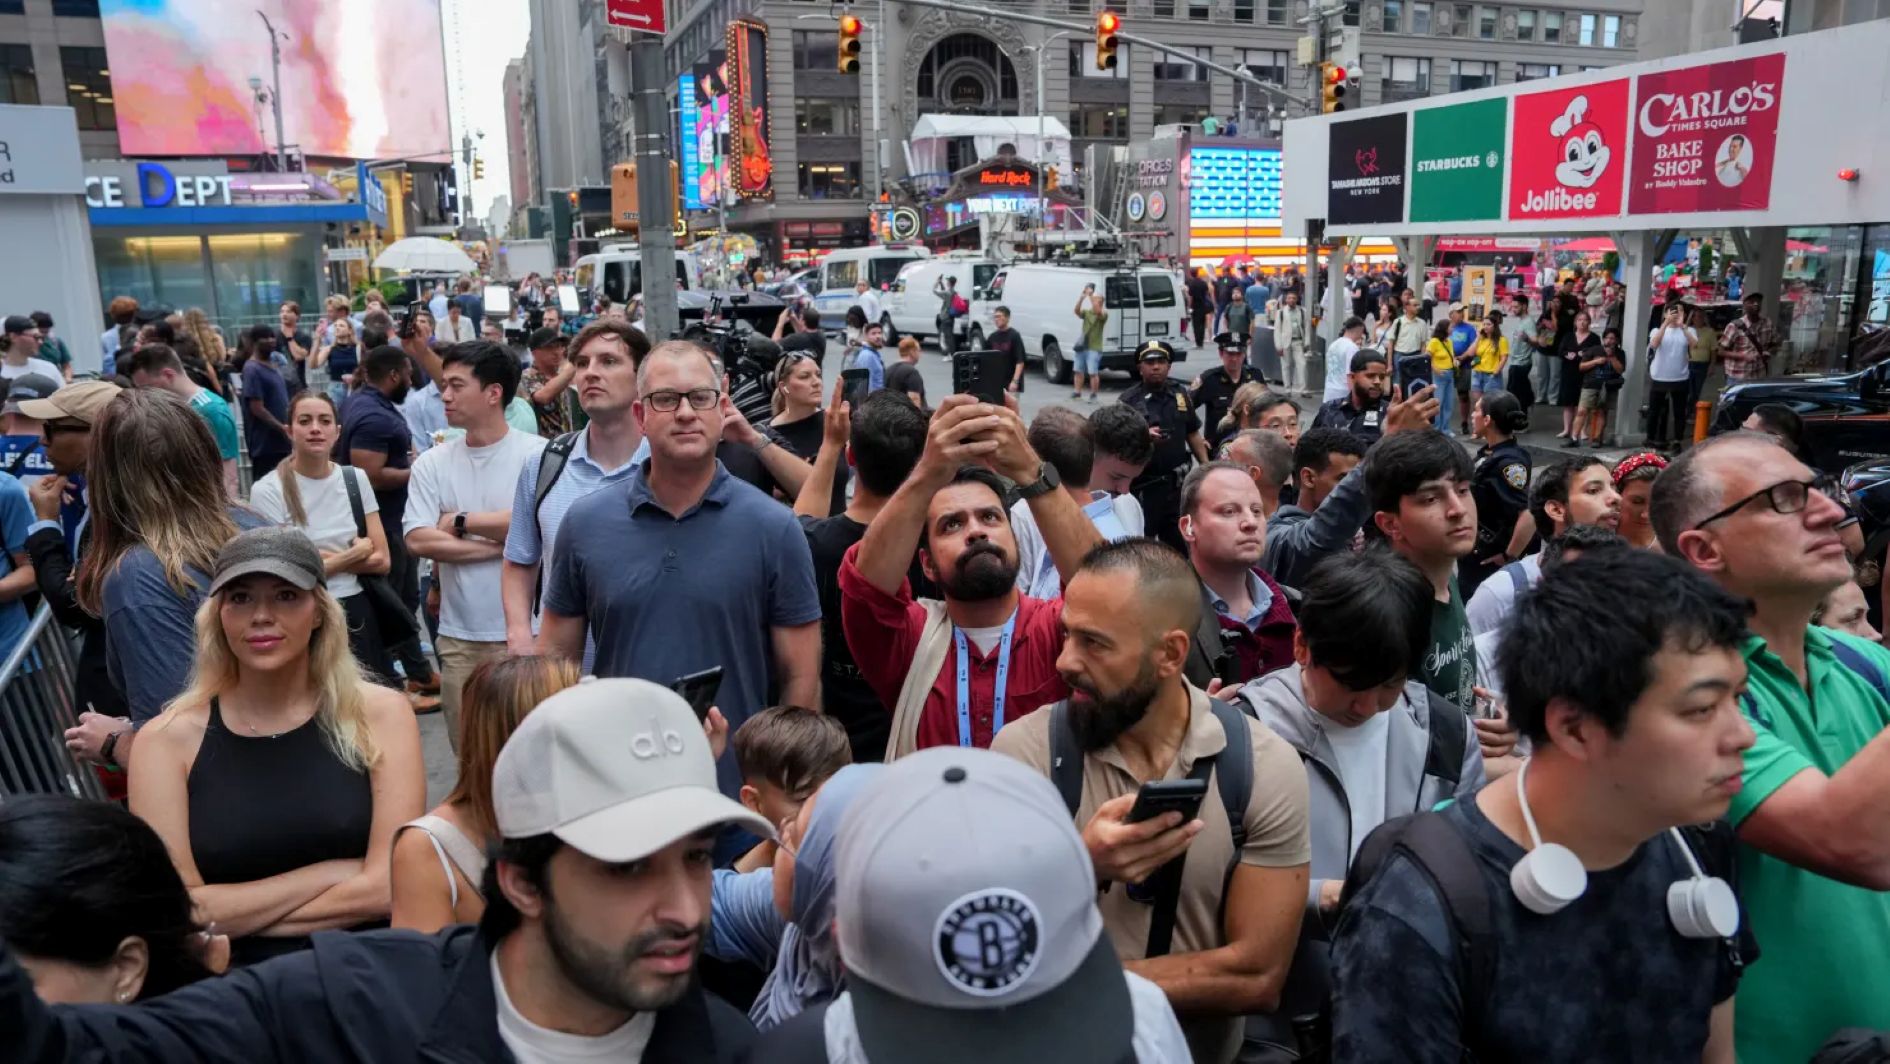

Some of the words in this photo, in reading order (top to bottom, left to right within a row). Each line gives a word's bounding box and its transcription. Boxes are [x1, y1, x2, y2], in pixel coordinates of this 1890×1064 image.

[1639, 80, 1775, 137] CARLO'S
[1671, 120, 1701, 132] TIMES
[1704, 116, 1748, 130] SQUARE
[1656, 140, 1703, 159] BAKE
[1416, 154, 1481, 172] STARBUCKS
[1653, 159, 1703, 177] SHOP
[136, 162, 234, 208] DEPT
[981, 171, 1006, 184] Hard
[1006, 171, 1031, 186] Rock
[1521, 186, 1595, 212] Jollibee
